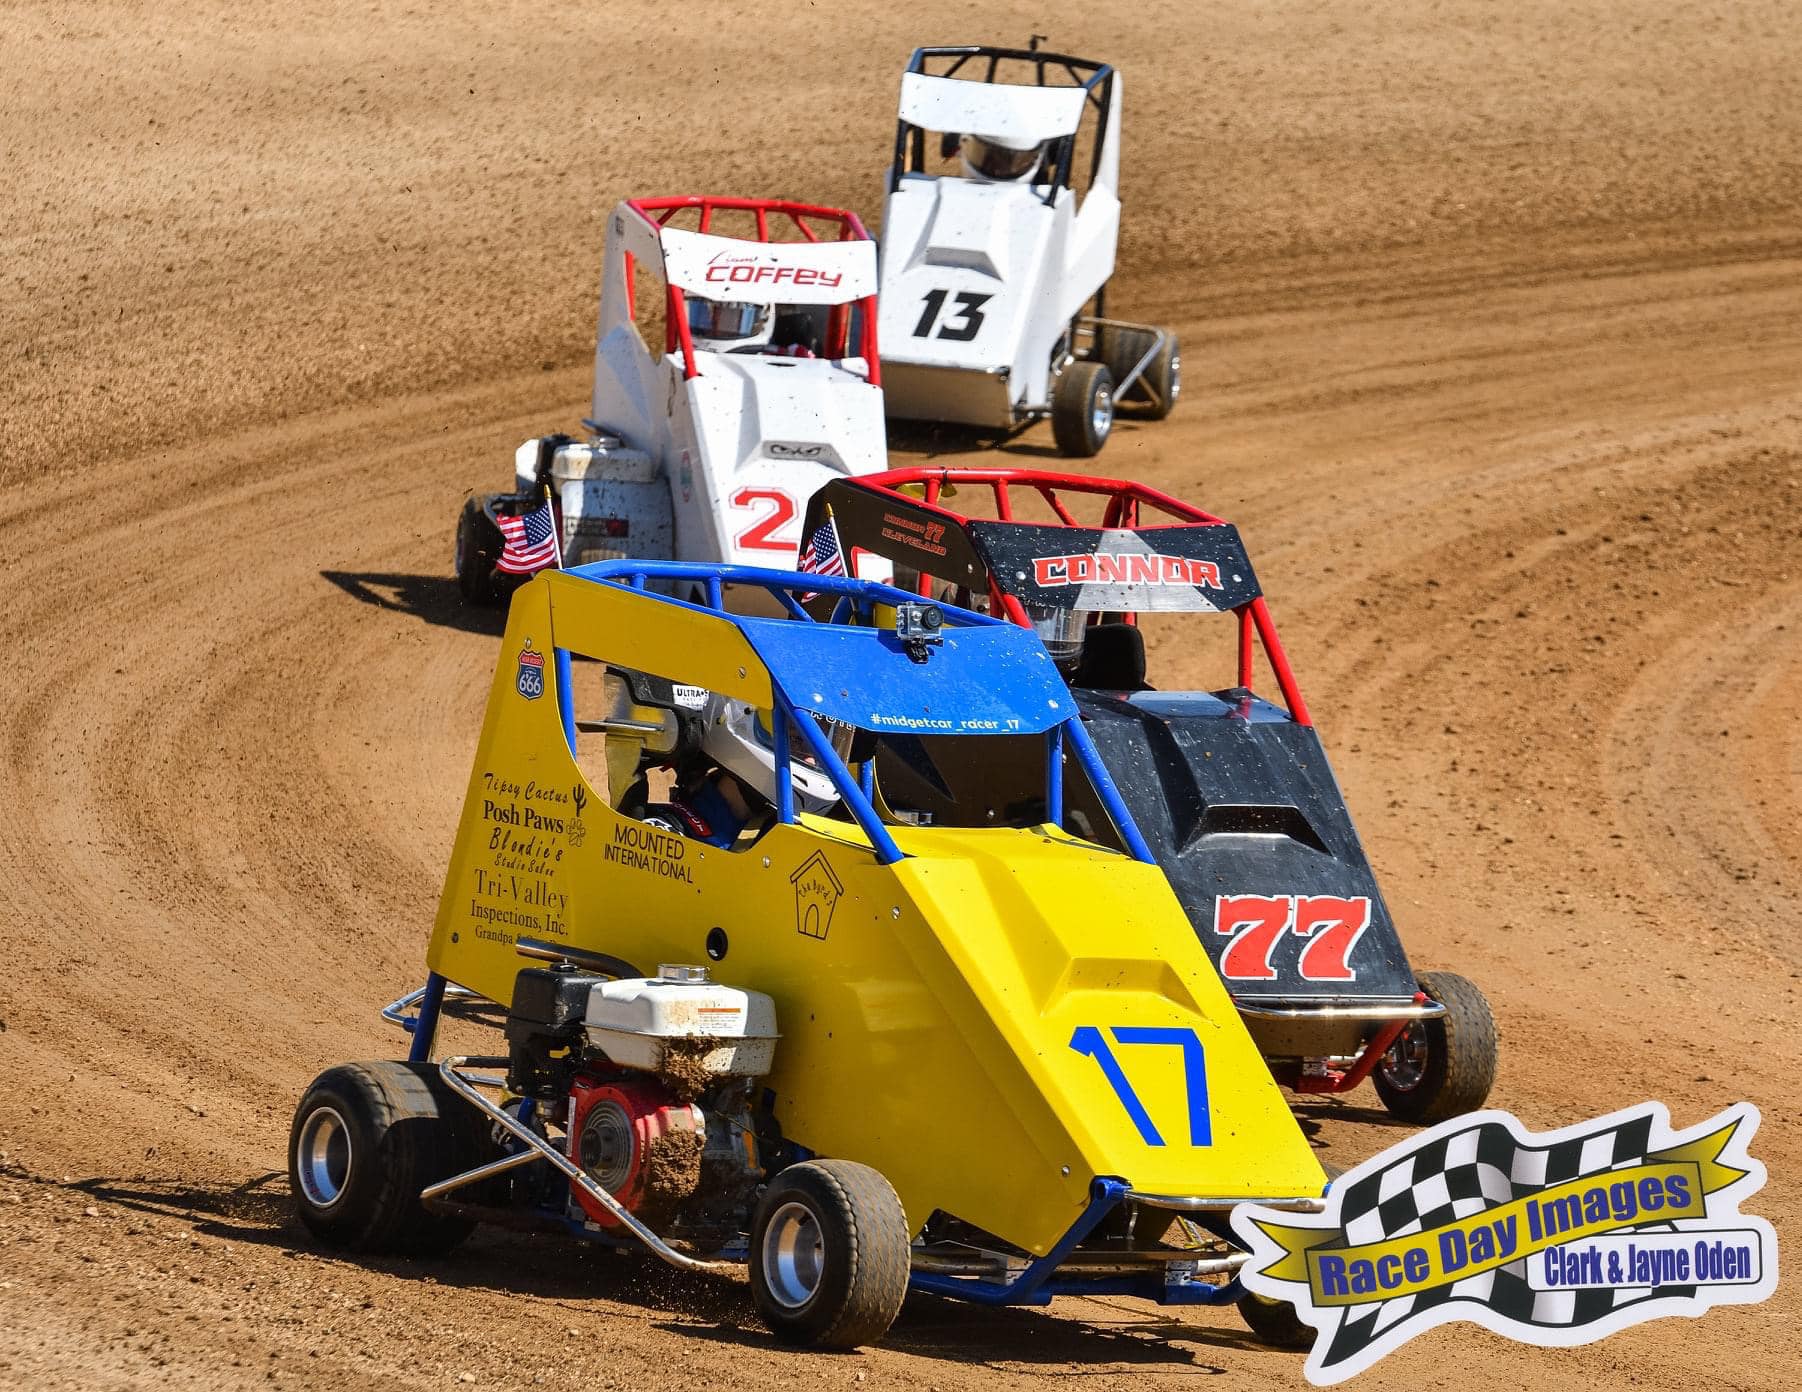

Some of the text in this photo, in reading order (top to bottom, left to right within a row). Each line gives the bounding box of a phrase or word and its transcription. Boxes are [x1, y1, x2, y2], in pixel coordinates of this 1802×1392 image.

[912, 289, 995, 342] 13
[924, 521, 945, 543] 77
[1031, 552, 1225, 590] CONNOR
[519, 673, 541, 694] 666
[484, 772, 568, 804] Tipsy Cactus
[483, 800, 564, 834] Posh Paws
[489, 827, 564, 862] Blondie's
[614, 823, 685, 860] MOUNTED
[494, 853, 526, 871] Studio
[604, 844, 693, 884] INTERNATIONAL
[474, 868, 569, 918] Tri-Valley
[471, 899, 569, 936] Inspections, Inc.
[475, 925, 513, 946] Grandpa
[1213, 893, 1372, 982] 77
[1067, 1026, 1213, 1147] 17
